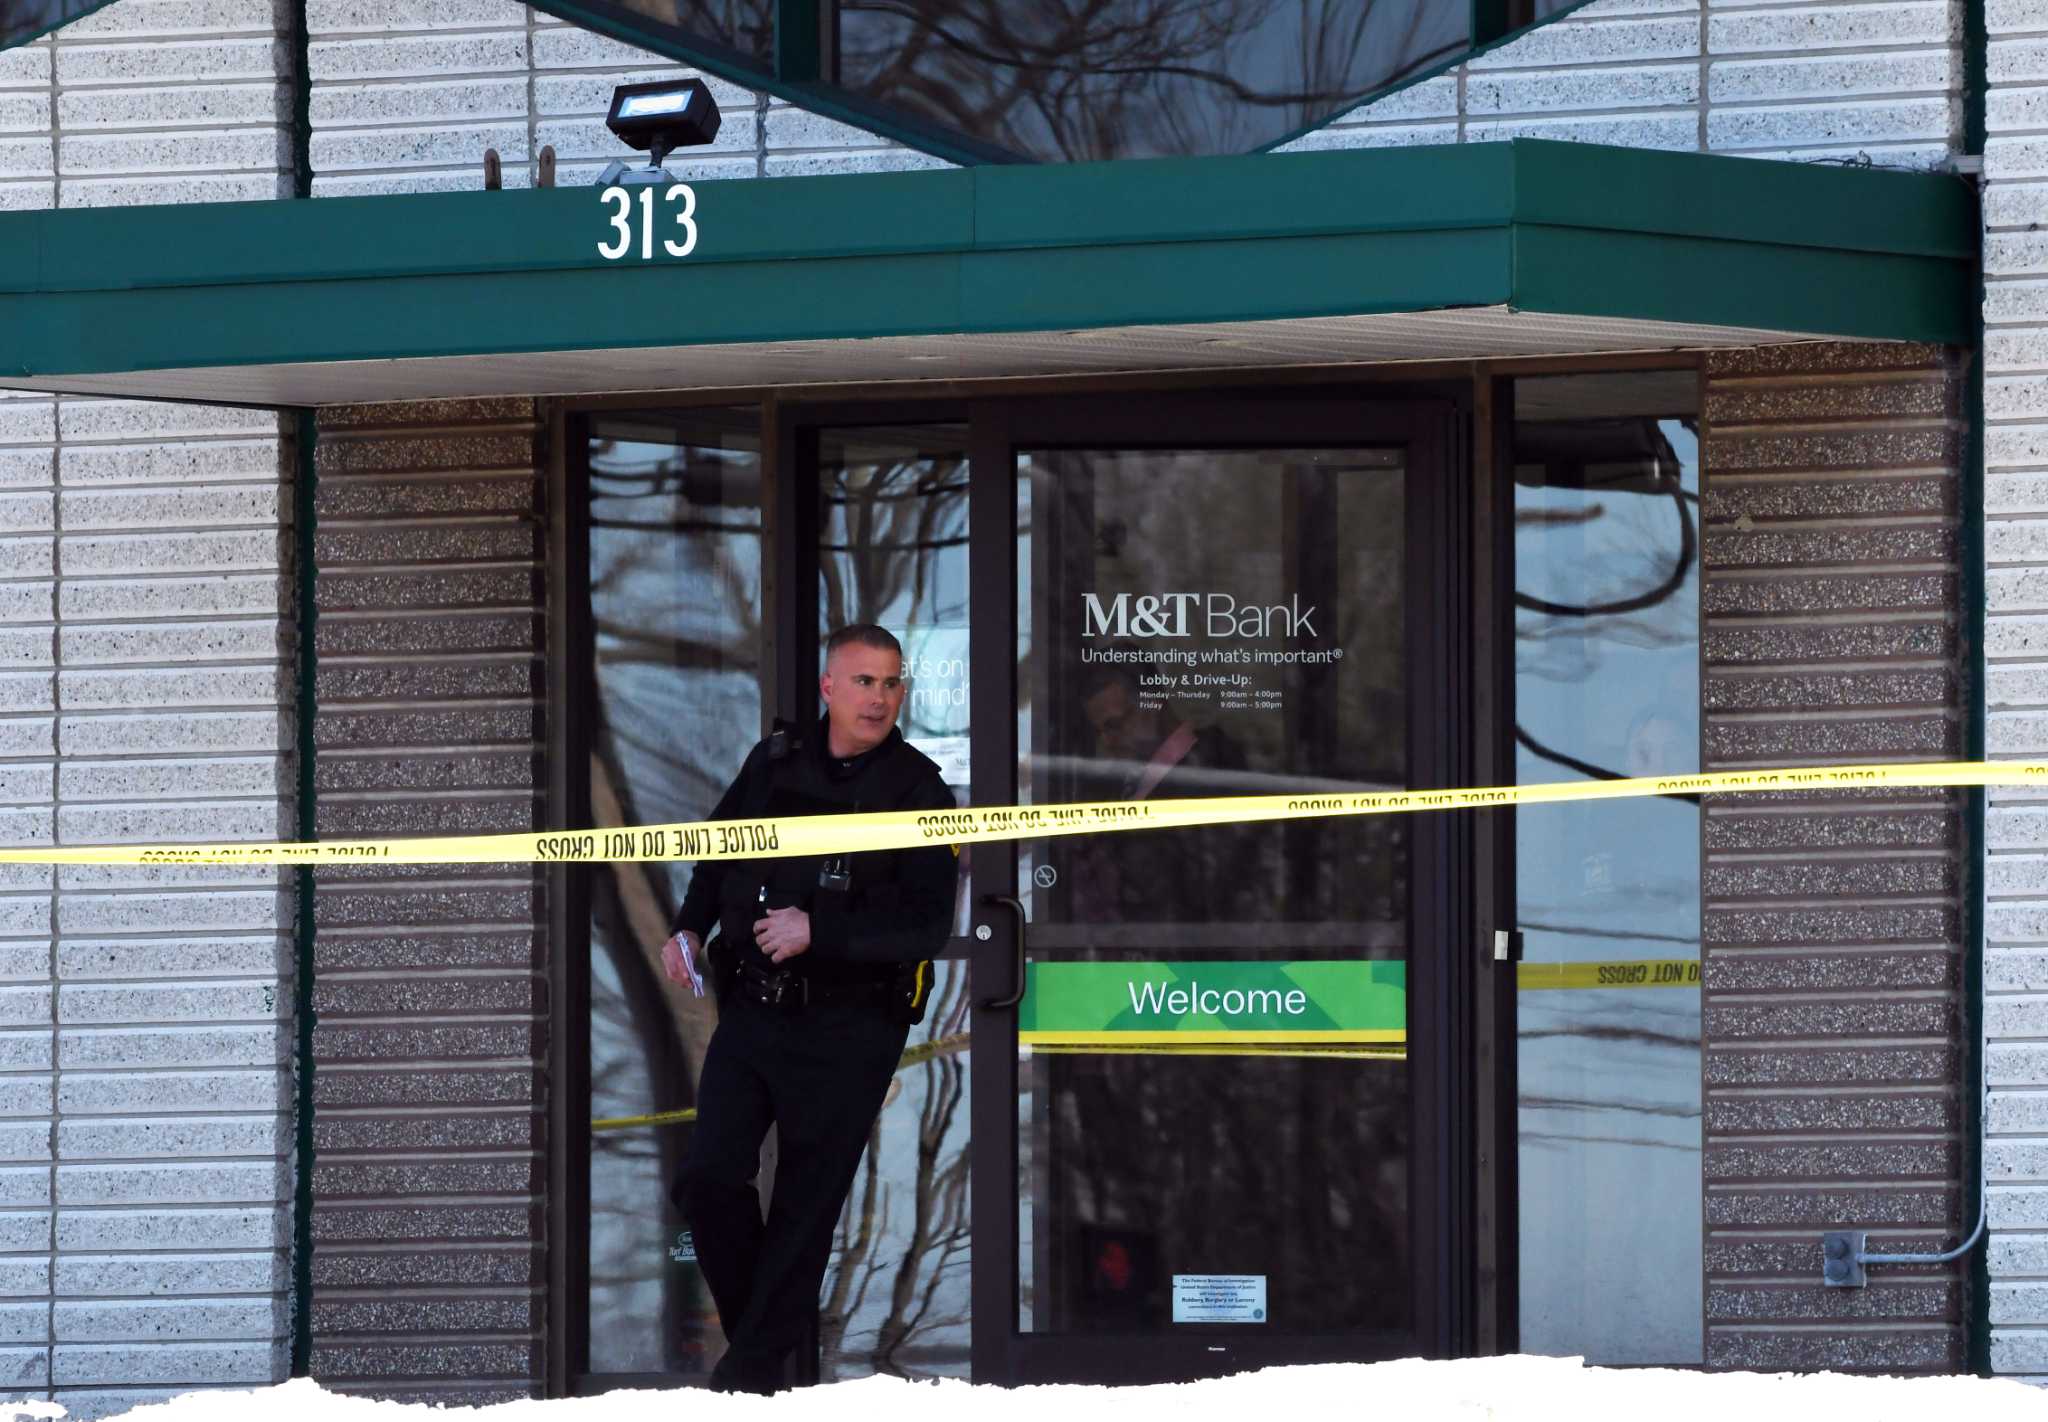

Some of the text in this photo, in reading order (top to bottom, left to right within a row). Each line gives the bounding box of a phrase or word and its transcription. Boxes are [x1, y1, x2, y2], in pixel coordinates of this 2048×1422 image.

[597, 184, 698, 260] 313
[1081, 592, 1318, 638] M&T Bank
[900, 656, 964, 679] at's on
[1081, 647, 1198, 667] Understanding
[1200, 647, 1251, 664] what's
[1139, 674, 1252, 688] Lobby & Drive-Up:
[1139, 691, 1170, 700] Monday
[1177, 691, 1211, 700] Thursday
[1139, 701, 1163, 711] Friday
[536, 823, 779, 860] POLICE LINE DO NOT CROSS
[1597, 964, 1648, 984] CROSS
[1651, 963, 1683, 984] NOT
[1128, 981, 1307, 1015] Welcome
